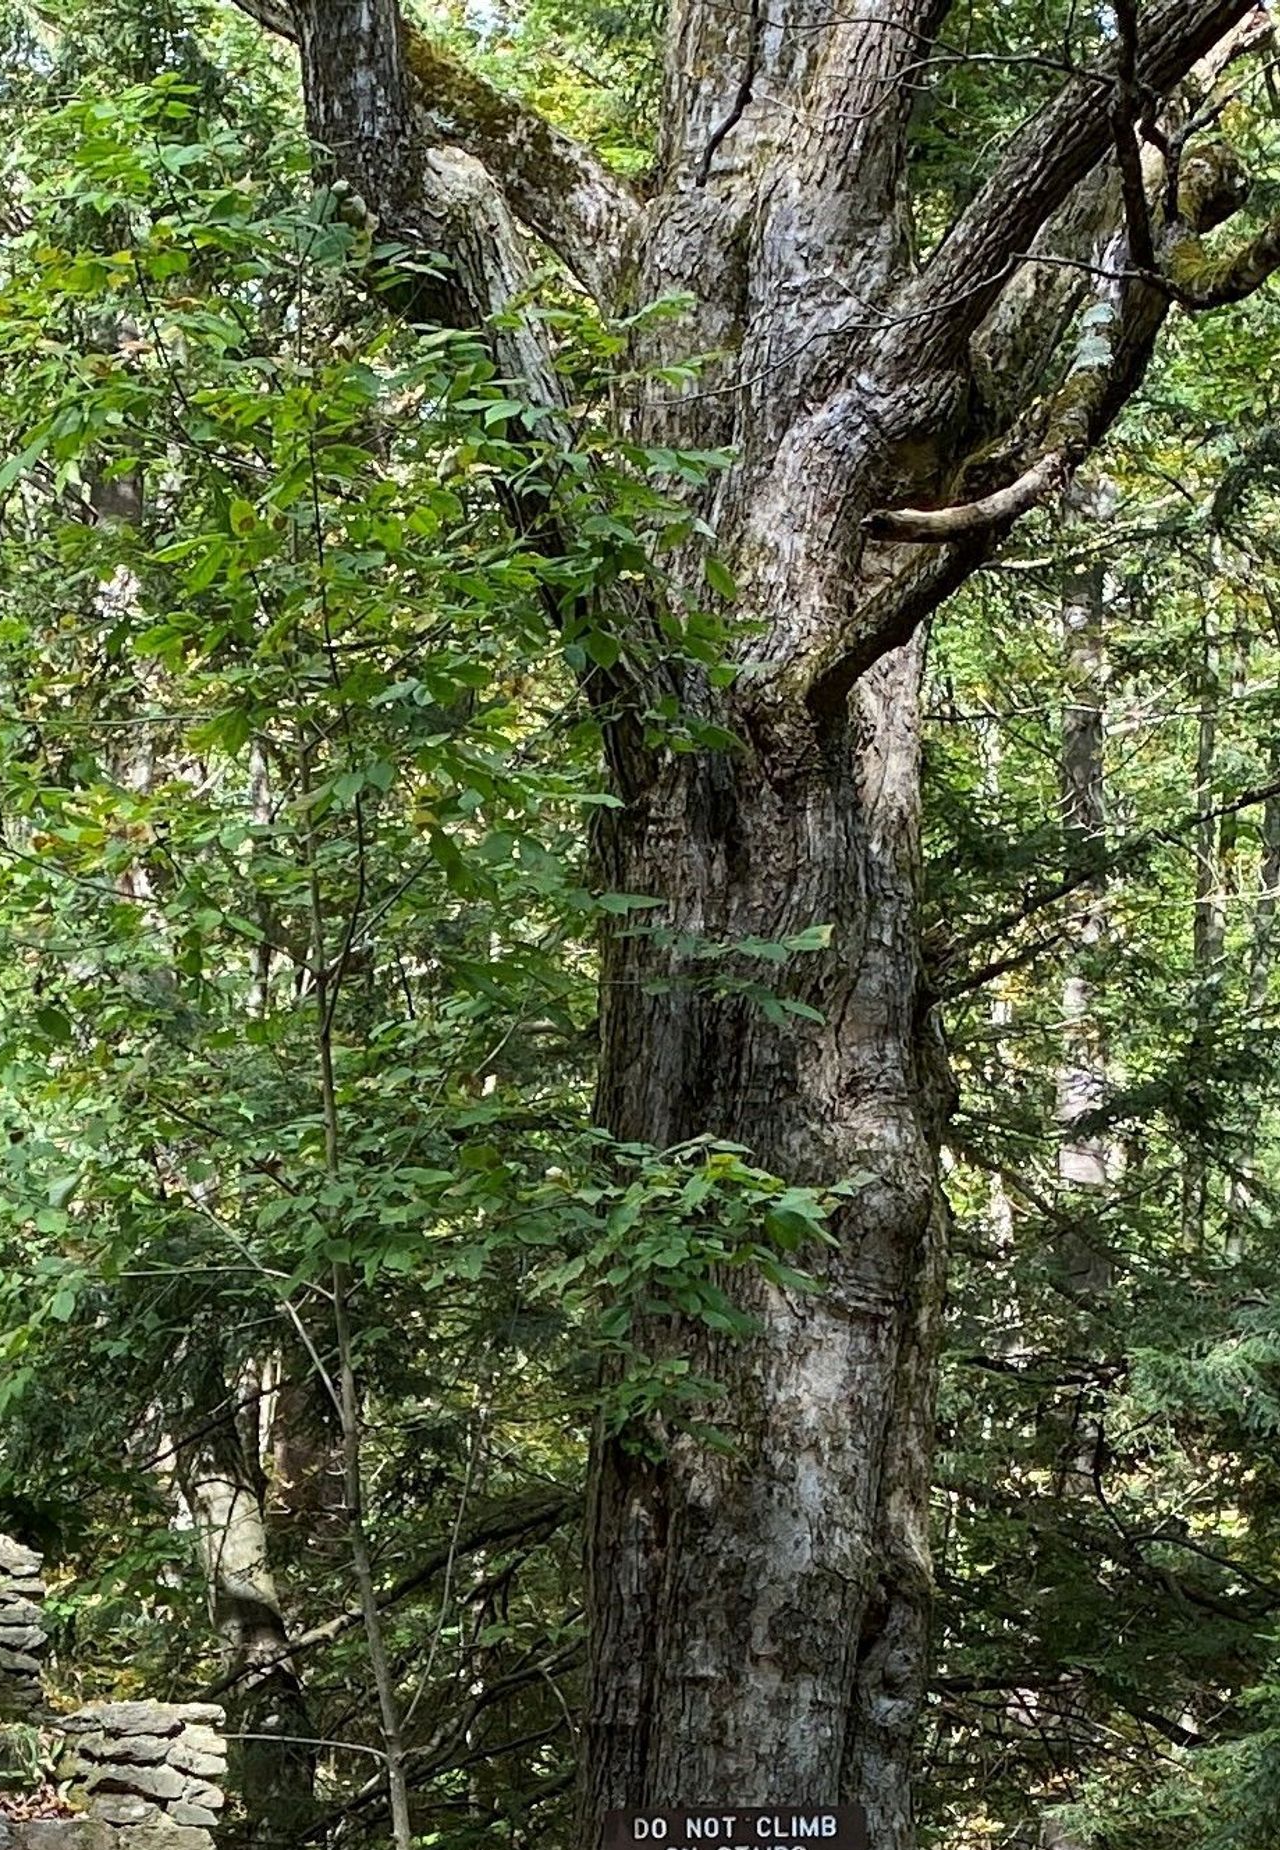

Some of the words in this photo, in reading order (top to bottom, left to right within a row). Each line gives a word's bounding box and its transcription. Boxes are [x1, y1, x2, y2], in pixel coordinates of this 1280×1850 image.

[634, 1817, 668, 1840] DO
[686, 1816, 737, 1839] NOT
[756, 1815, 838, 1838] CLIMB
